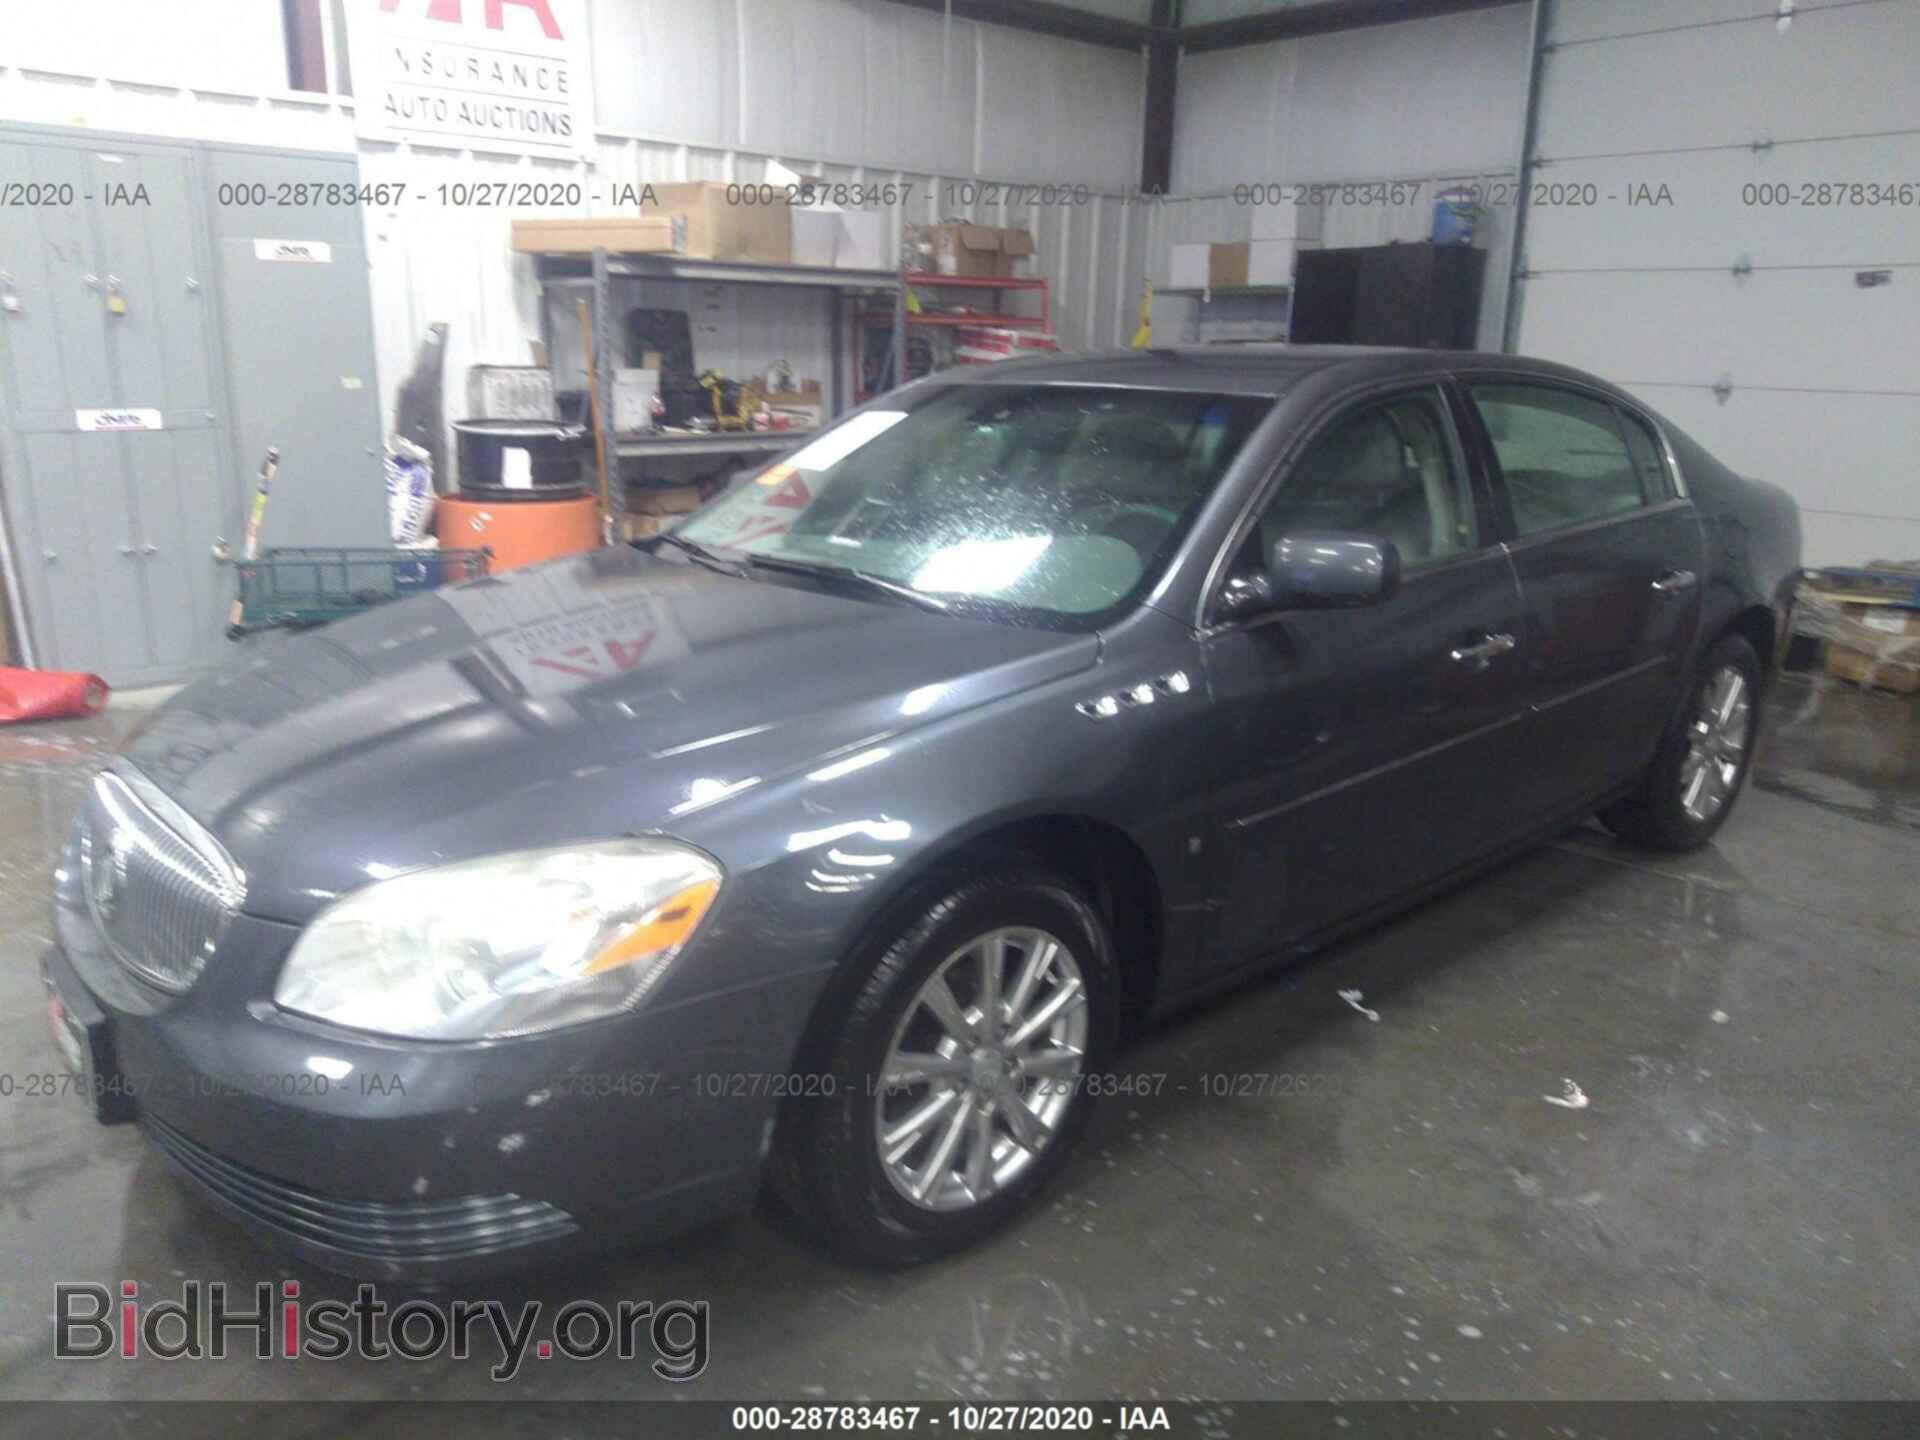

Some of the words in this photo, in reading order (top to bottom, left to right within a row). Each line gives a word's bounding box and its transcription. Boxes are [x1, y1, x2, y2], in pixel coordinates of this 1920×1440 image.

[394, 47, 568, 94] NSURANCE
[385, 93, 448, 121] AUTO
[458, 101, 572, 137] AUCTIONS
